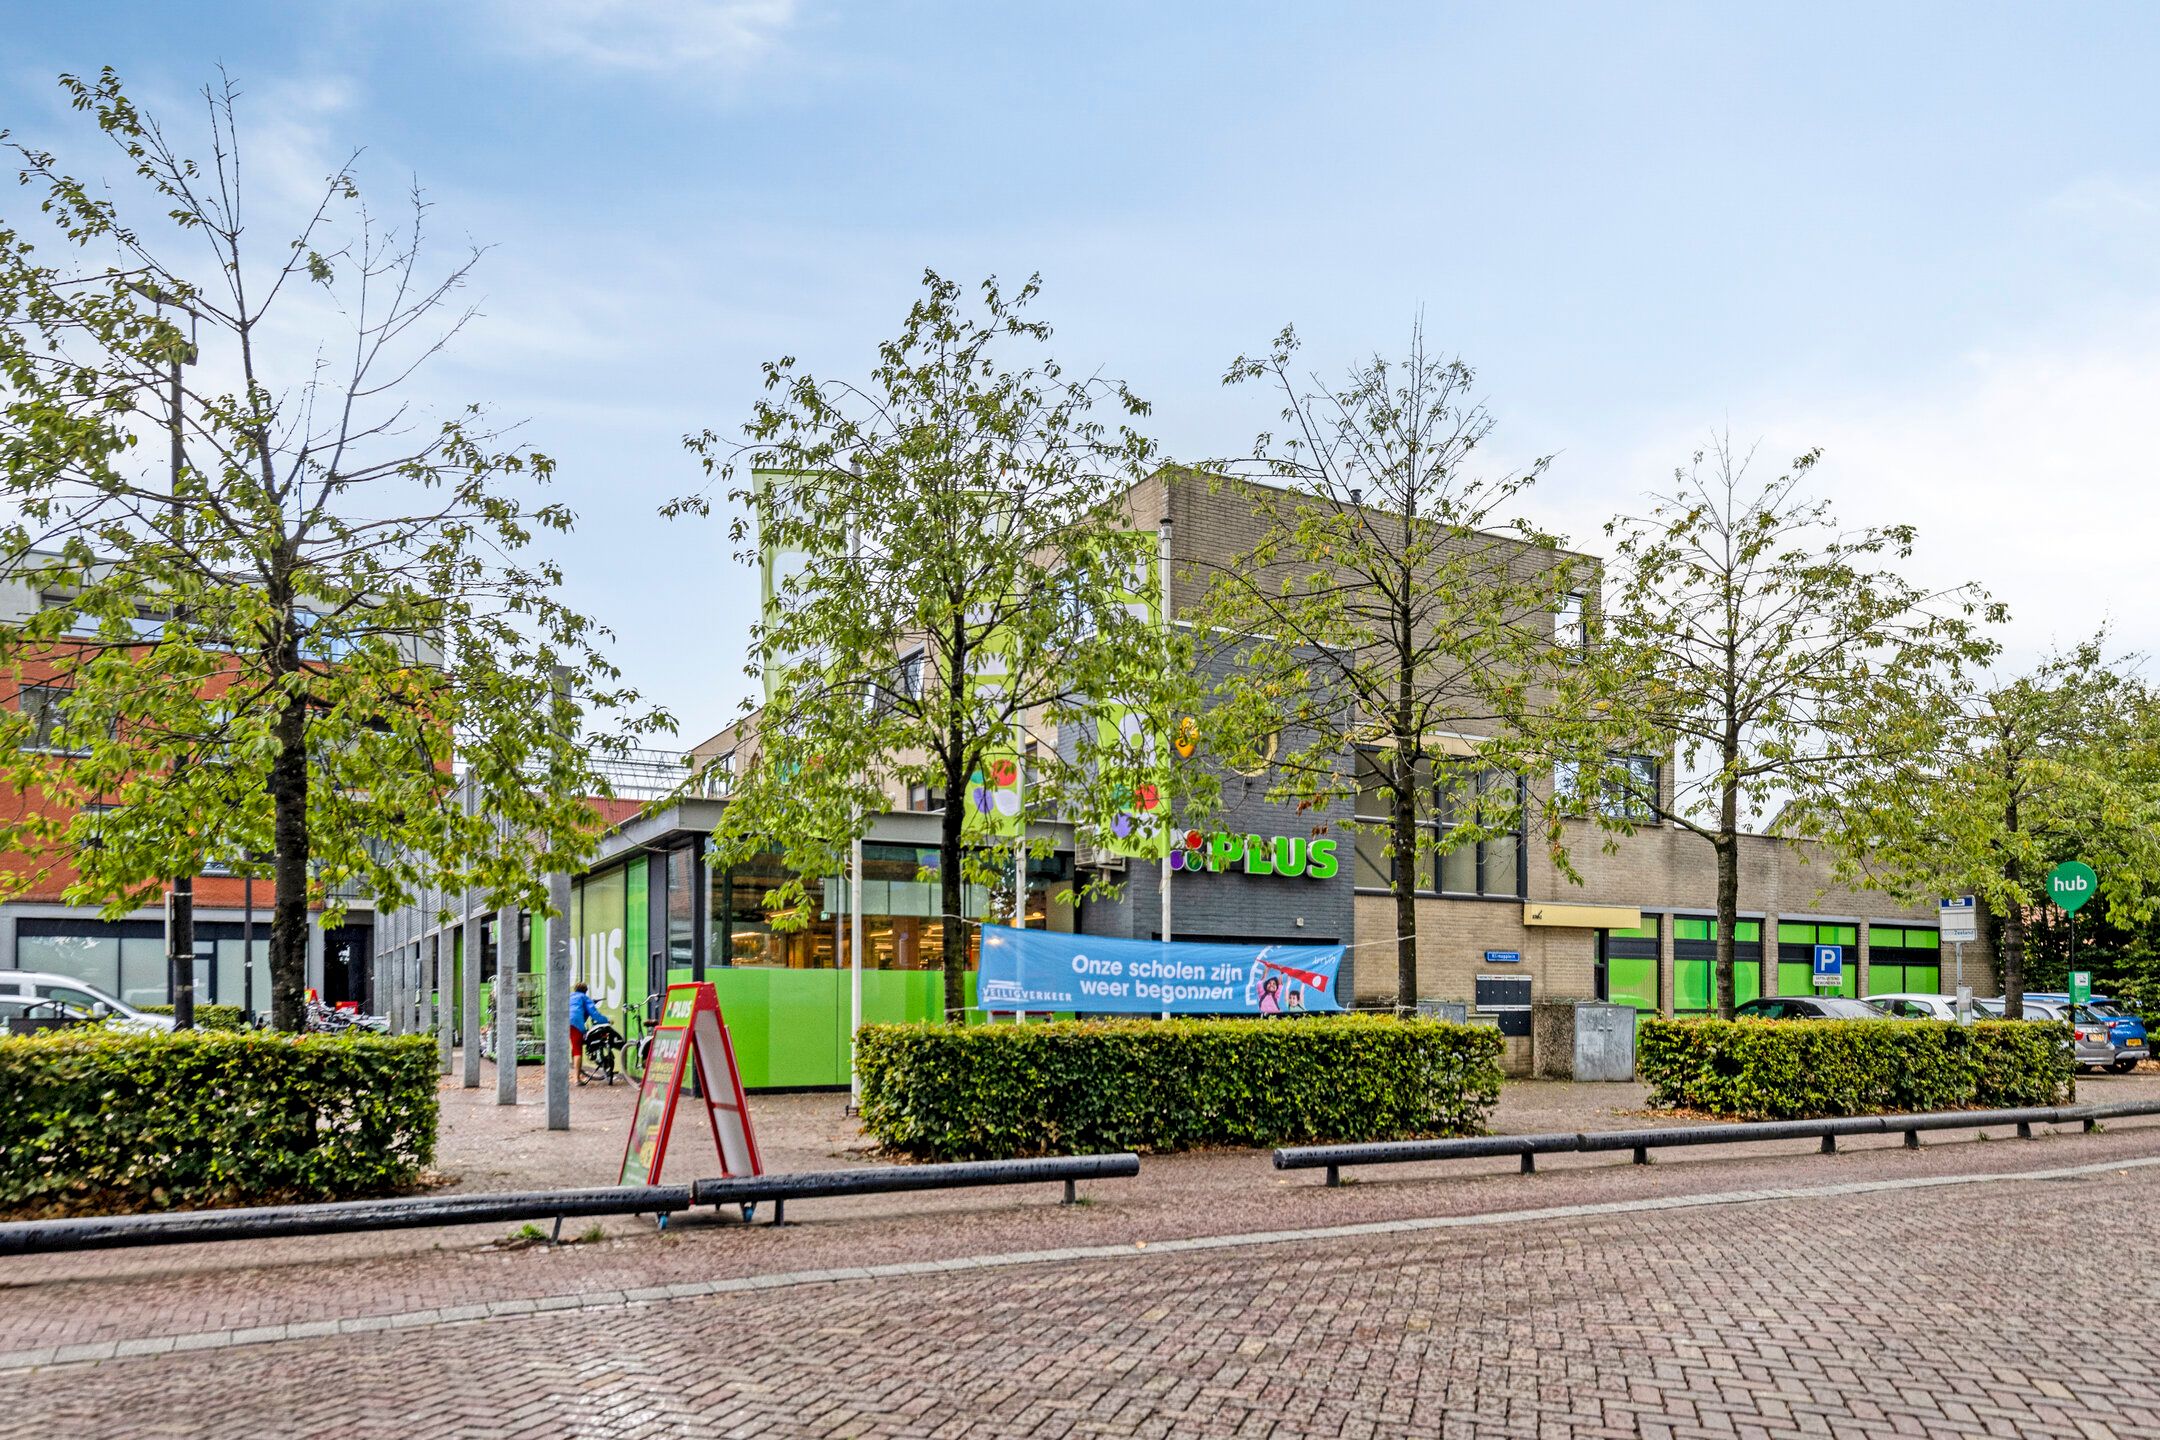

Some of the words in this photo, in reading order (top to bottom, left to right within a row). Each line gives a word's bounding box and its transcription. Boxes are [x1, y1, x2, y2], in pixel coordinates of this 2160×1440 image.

[1207, 832, 1339, 879] PLUS
[2053, 875, 2088, 891] hub
[1071, 954, 1123, 975] Onze
[1128, 960, 1206, 980] scholen
[1210, 963, 1243, 985] zijn
[1821, 949, 1836, 971] P
[1080, 980, 1130, 997] weer
[1135, 980, 1234, 1004] begonnen
[672, 1000, 692, 1018] PLUS
[657, 1038, 680, 1058] PLUS
